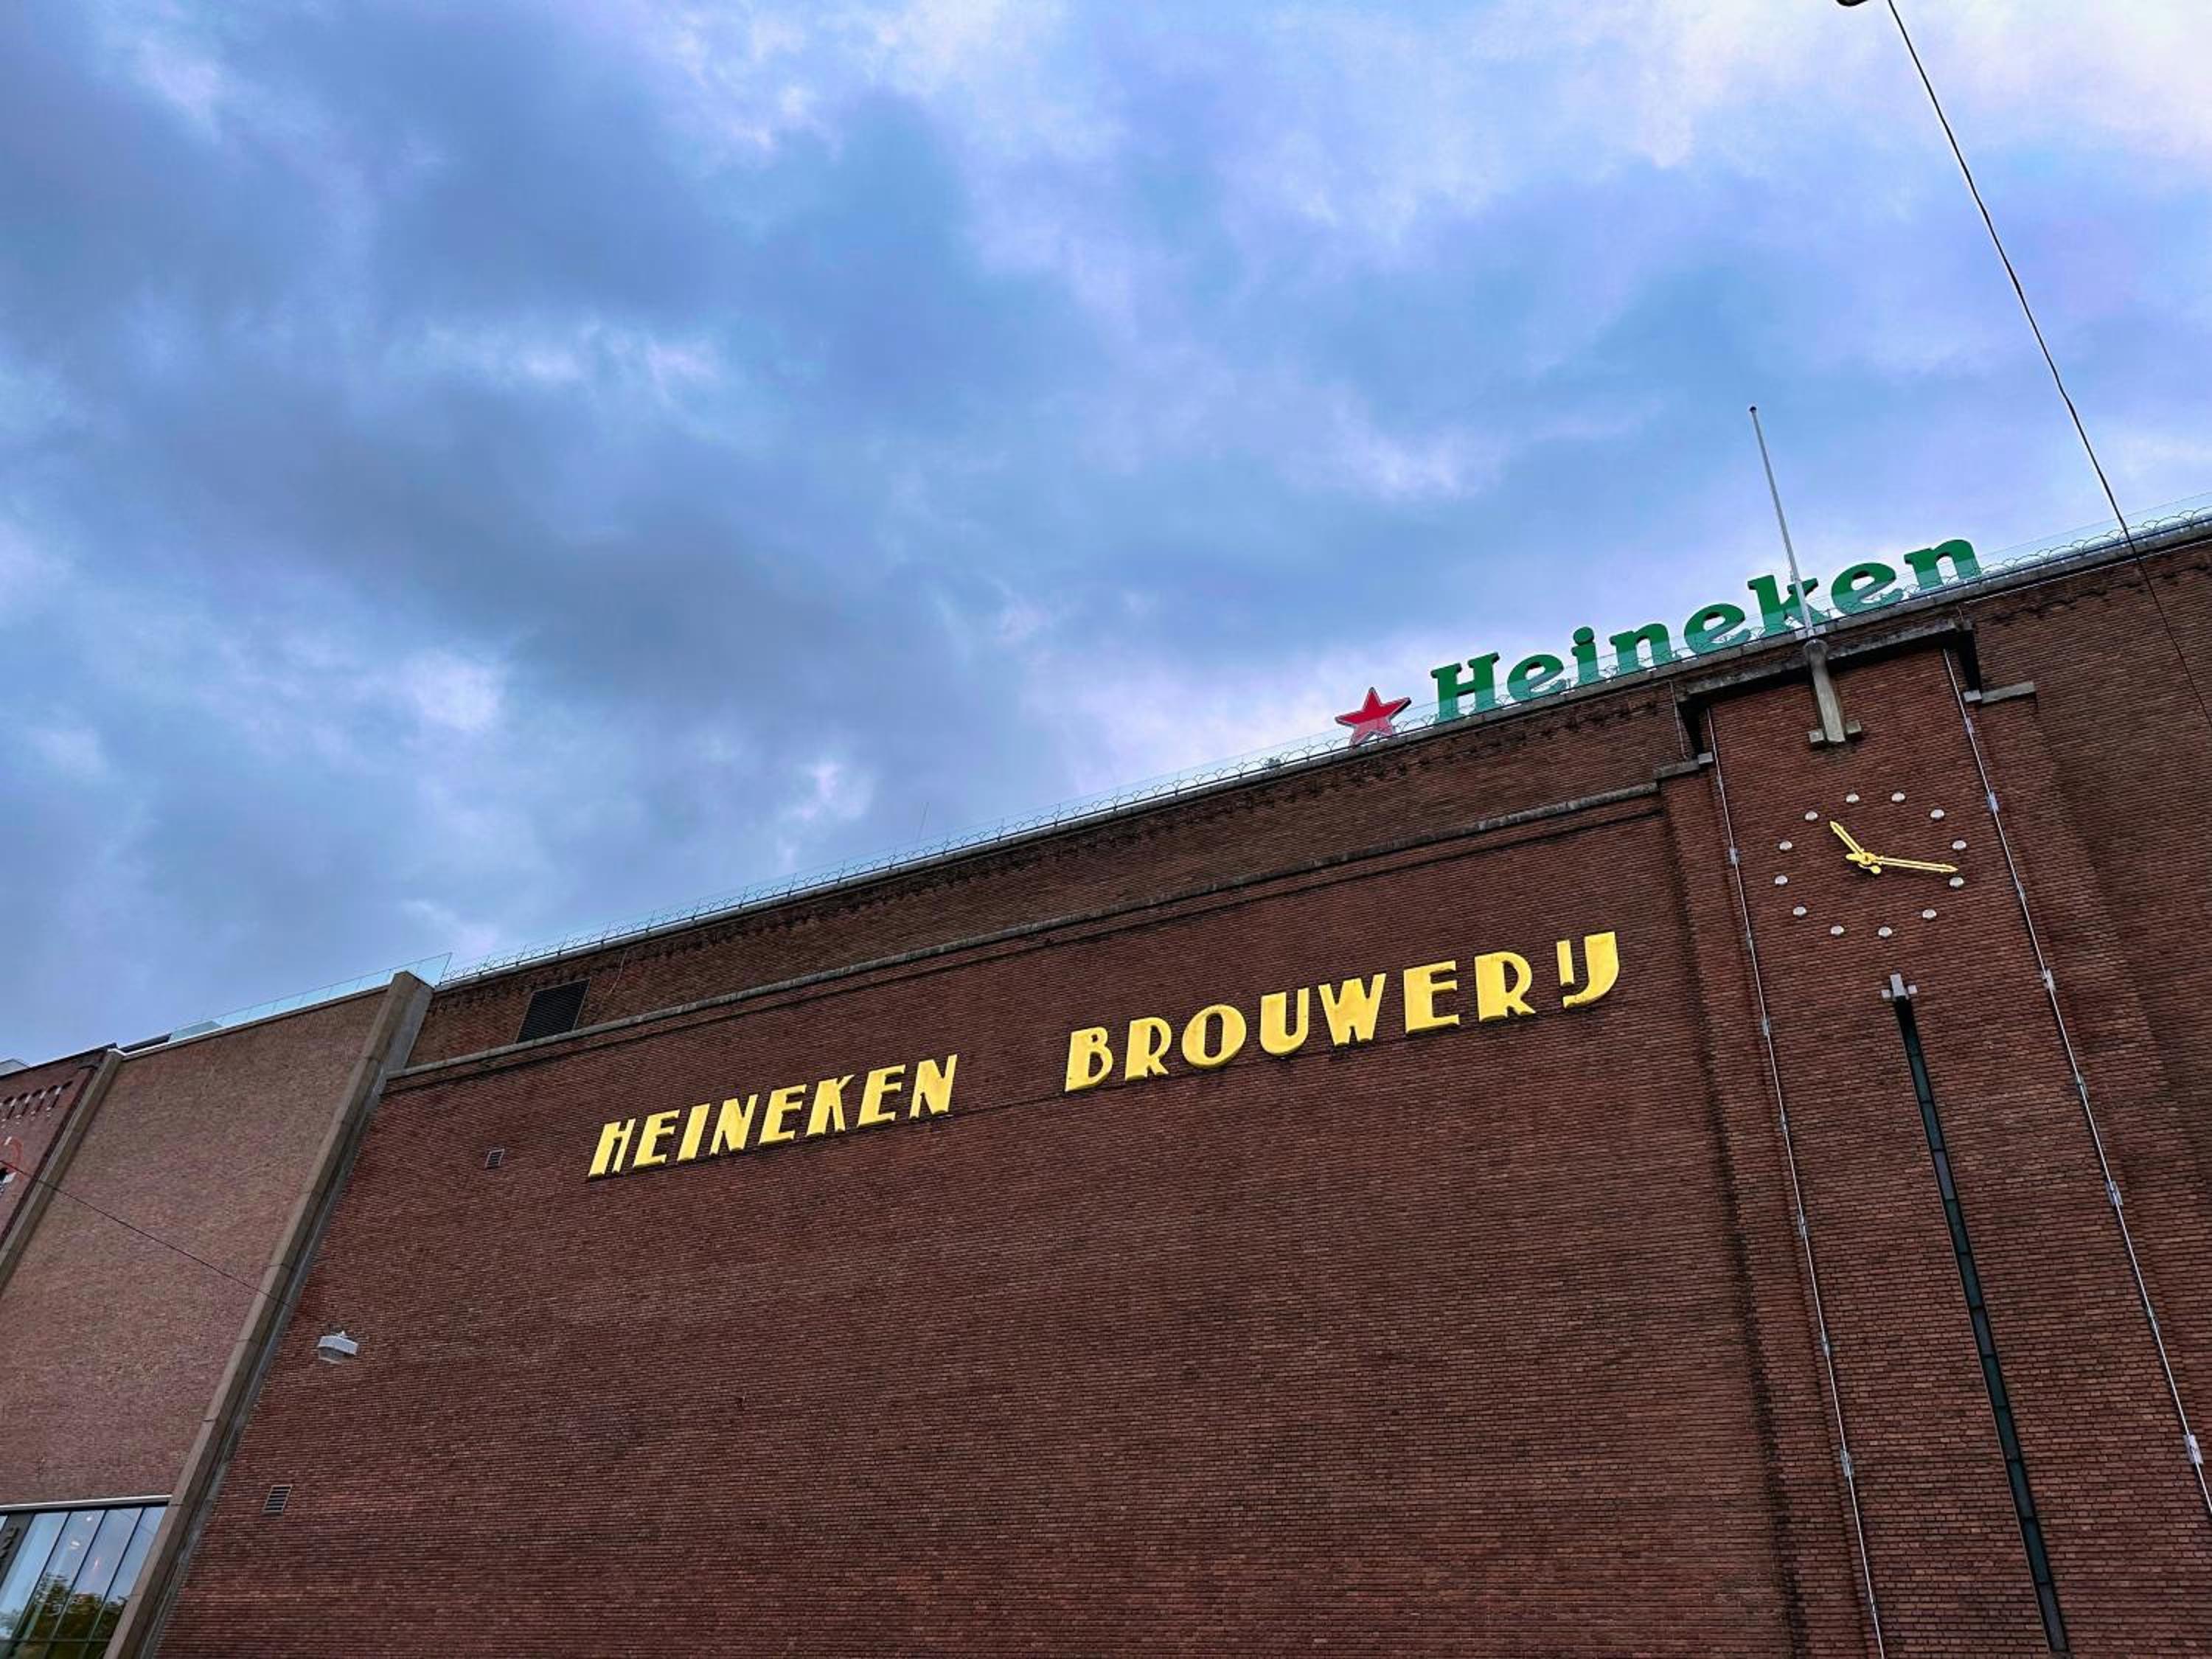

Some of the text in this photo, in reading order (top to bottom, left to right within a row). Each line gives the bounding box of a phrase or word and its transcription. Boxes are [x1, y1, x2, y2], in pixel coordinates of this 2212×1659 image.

[1430, 538, 1981, 721] Heineken
[588, 931, 1620, 1178] HEINEKEN BROUWERIJ
